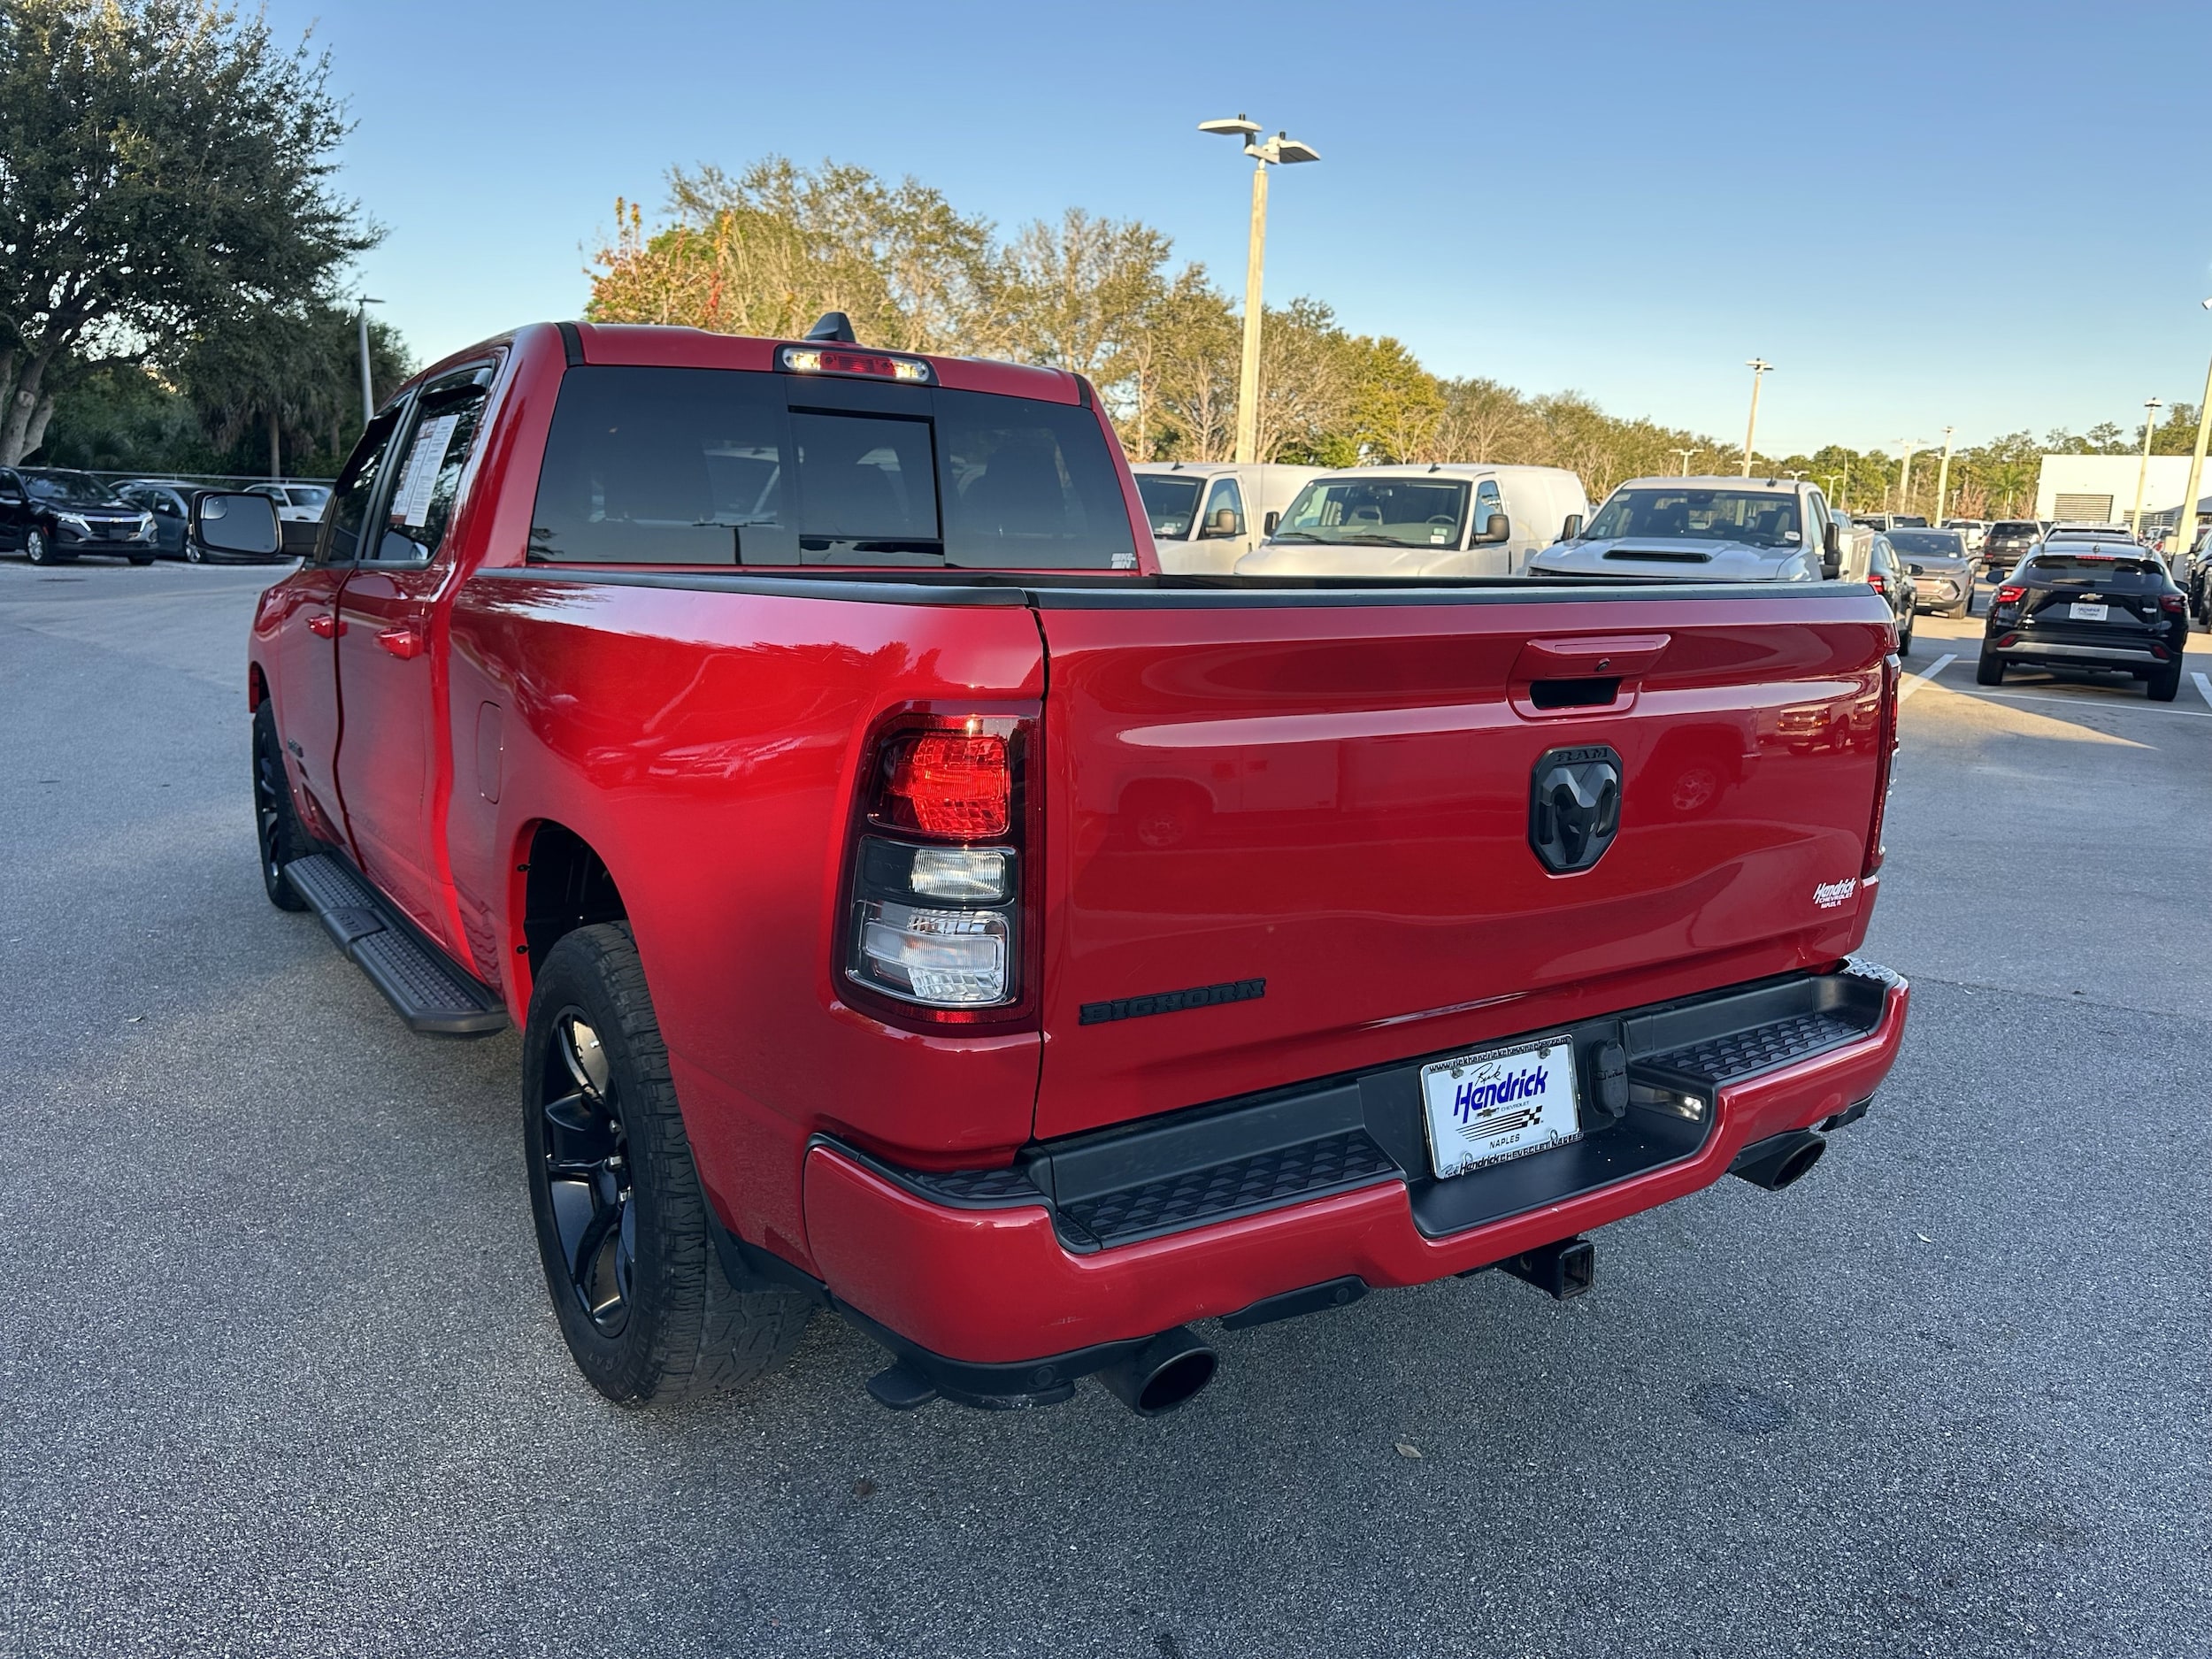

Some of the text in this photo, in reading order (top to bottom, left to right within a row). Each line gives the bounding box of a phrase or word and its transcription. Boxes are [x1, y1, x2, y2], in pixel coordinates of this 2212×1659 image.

[1555, 748, 1608, 762] RAM
[1813, 877, 1856, 904] Hendrick
[1079, 977, 1266, 1025] BIGHORN
[1454, 1065, 1548, 1124] Hendrick
[1501, 1101, 1530, 1112] CHEVROLET
[1460, 1154, 1502, 1176] Hendrick
[1501, 1141, 1549, 1162] CHEVROLET
[1550, 1132, 1583, 1148] NAPLES
[1489, 1133, 1521, 1149] NAPLES
